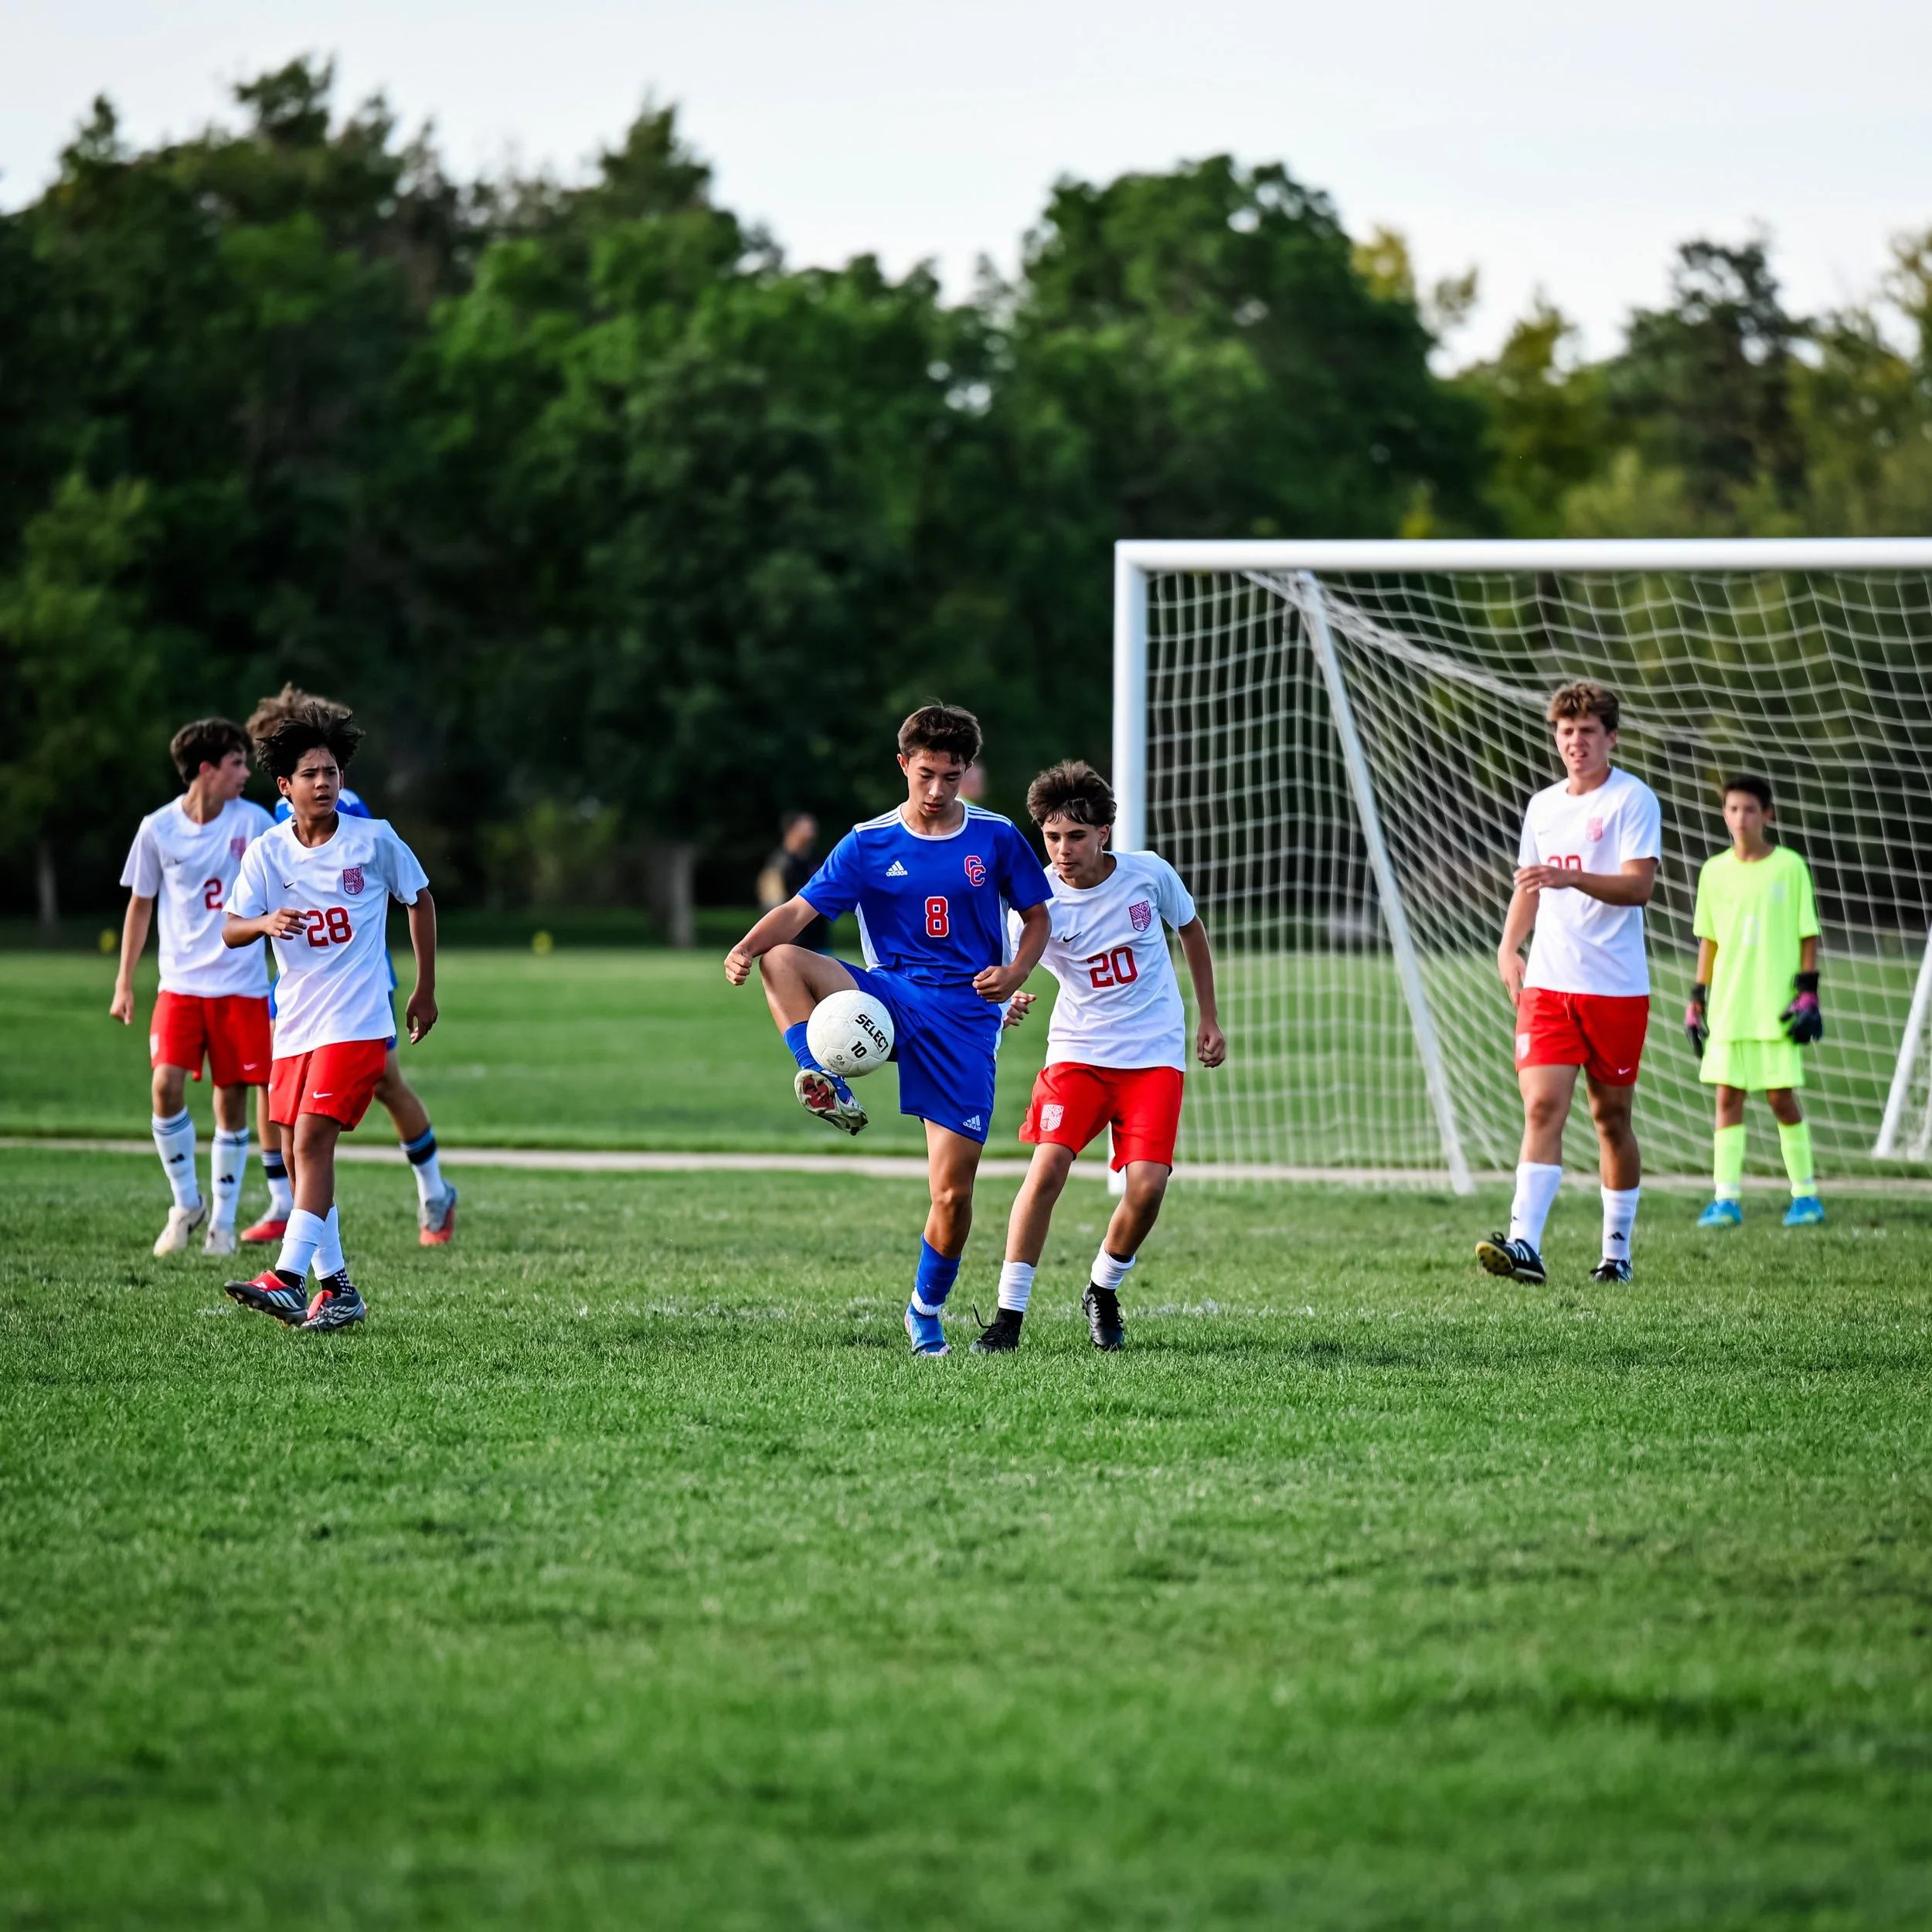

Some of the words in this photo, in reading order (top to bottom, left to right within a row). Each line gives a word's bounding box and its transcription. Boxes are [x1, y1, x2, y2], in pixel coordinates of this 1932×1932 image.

[204, 878, 223, 910] 2
[306, 906, 352, 947] 28
[925, 896, 949, 937] 8
[1087, 946, 1138, 988] 20
[851, 1040, 867, 1059] 10
[855, 1013, 889, 1053] SELECT
